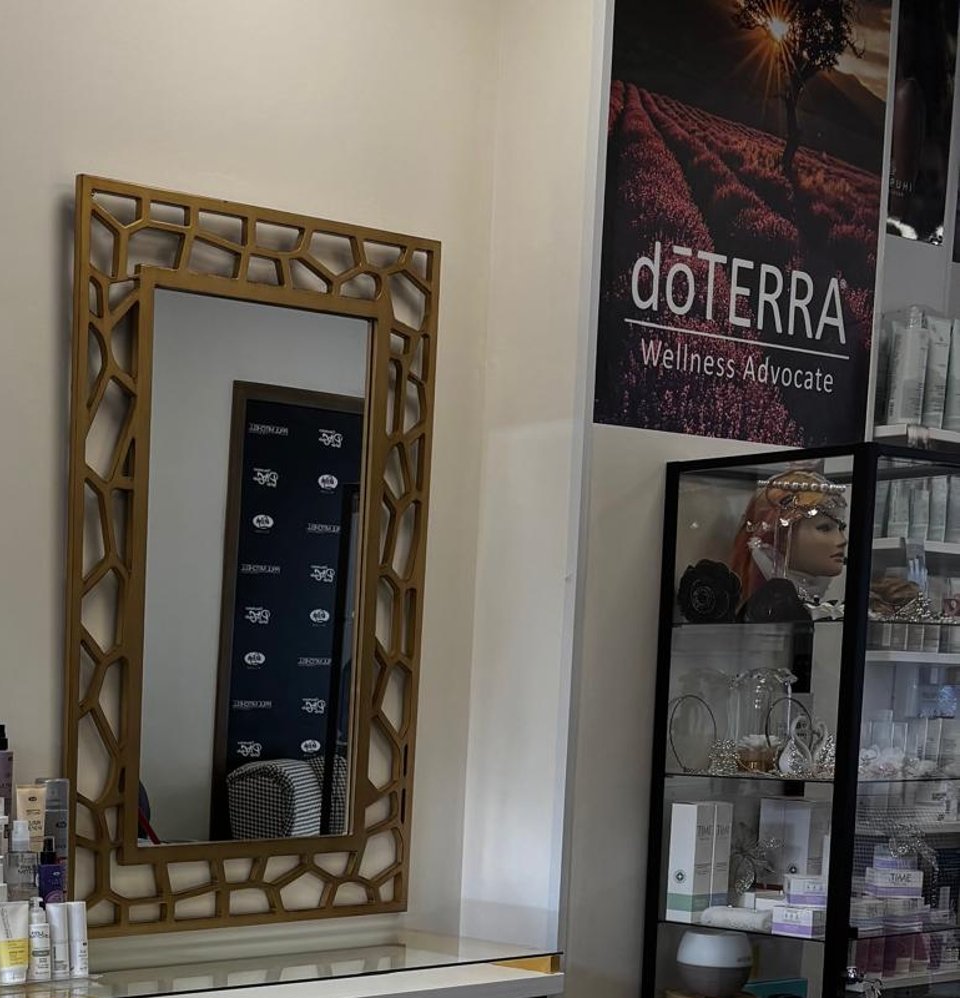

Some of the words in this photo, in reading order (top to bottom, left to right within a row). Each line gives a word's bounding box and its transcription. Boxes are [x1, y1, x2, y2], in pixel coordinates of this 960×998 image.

[641, 338, 736, 379] Wellness
[742, 354, 835, 393] Advocate
[888, 872, 913, 884] TIME
